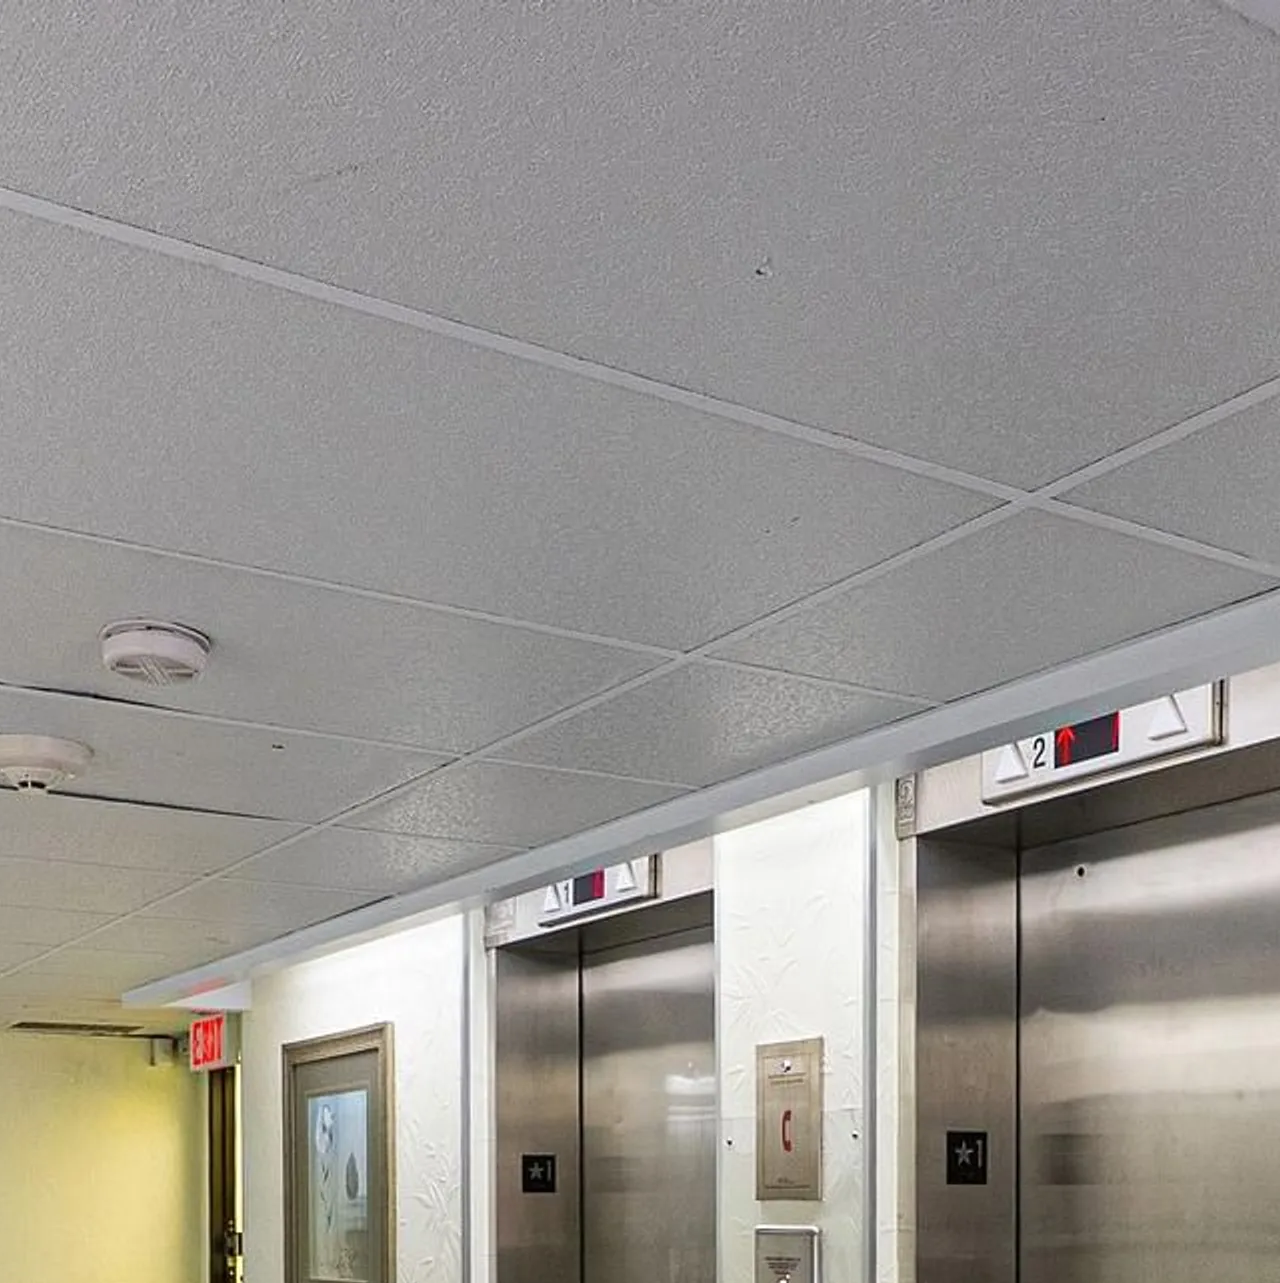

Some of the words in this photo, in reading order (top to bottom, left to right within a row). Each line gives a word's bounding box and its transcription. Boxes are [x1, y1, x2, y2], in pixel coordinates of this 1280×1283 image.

[1033, 737, 1046, 769] 2
[192, 1016, 224, 1066] EXIT
[976, 1140, 983, 1169] 1
